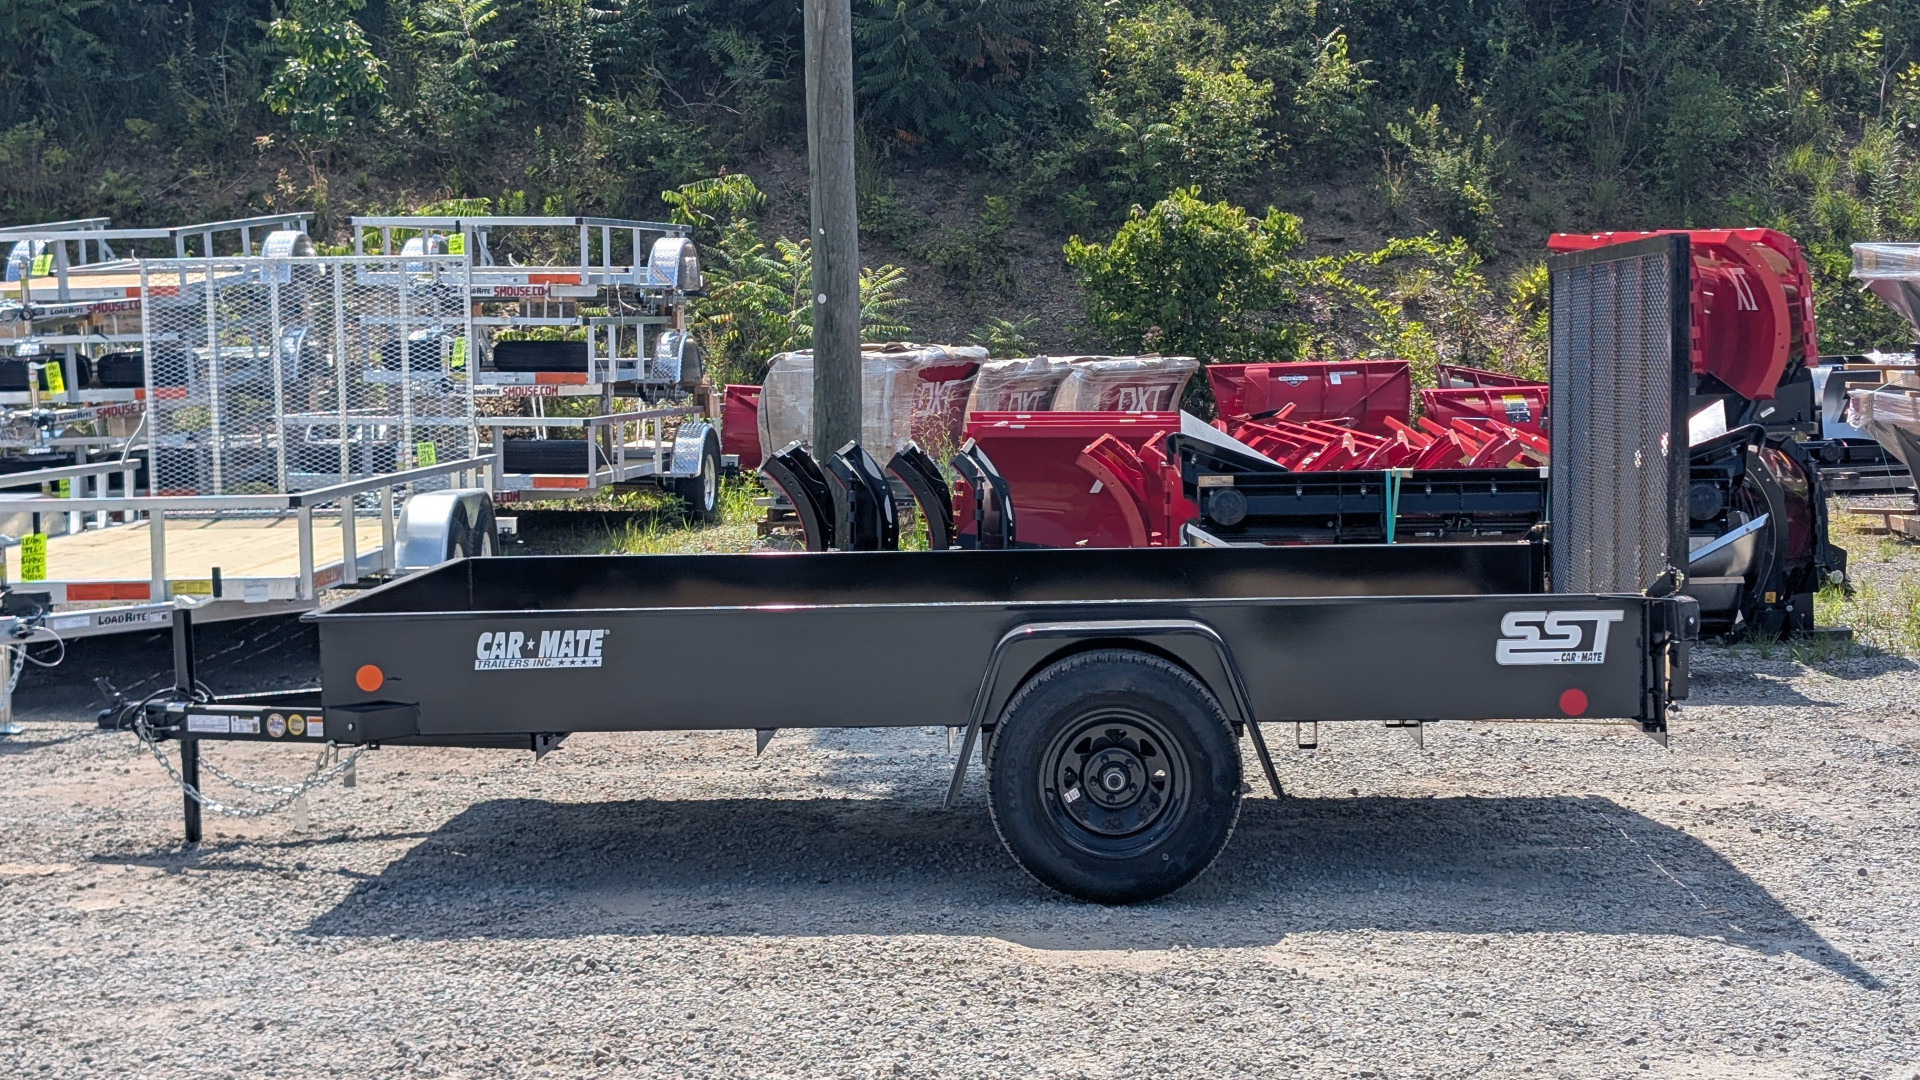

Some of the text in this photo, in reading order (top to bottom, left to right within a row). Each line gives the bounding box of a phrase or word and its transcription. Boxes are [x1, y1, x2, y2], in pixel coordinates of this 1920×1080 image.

[86, 299, 142, 315] SMOUSE.CO
[502, 385, 559, 398] SMOUSE.COM
[97, 611, 148, 626] LOADRITE
[476, 629, 605, 660] CAR MATE
[1495, 609, 1625, 666] SST
[476, 658, 555, 669] TRAILERS INC.
[1560, 651, 1603, 662] CAR MATE
